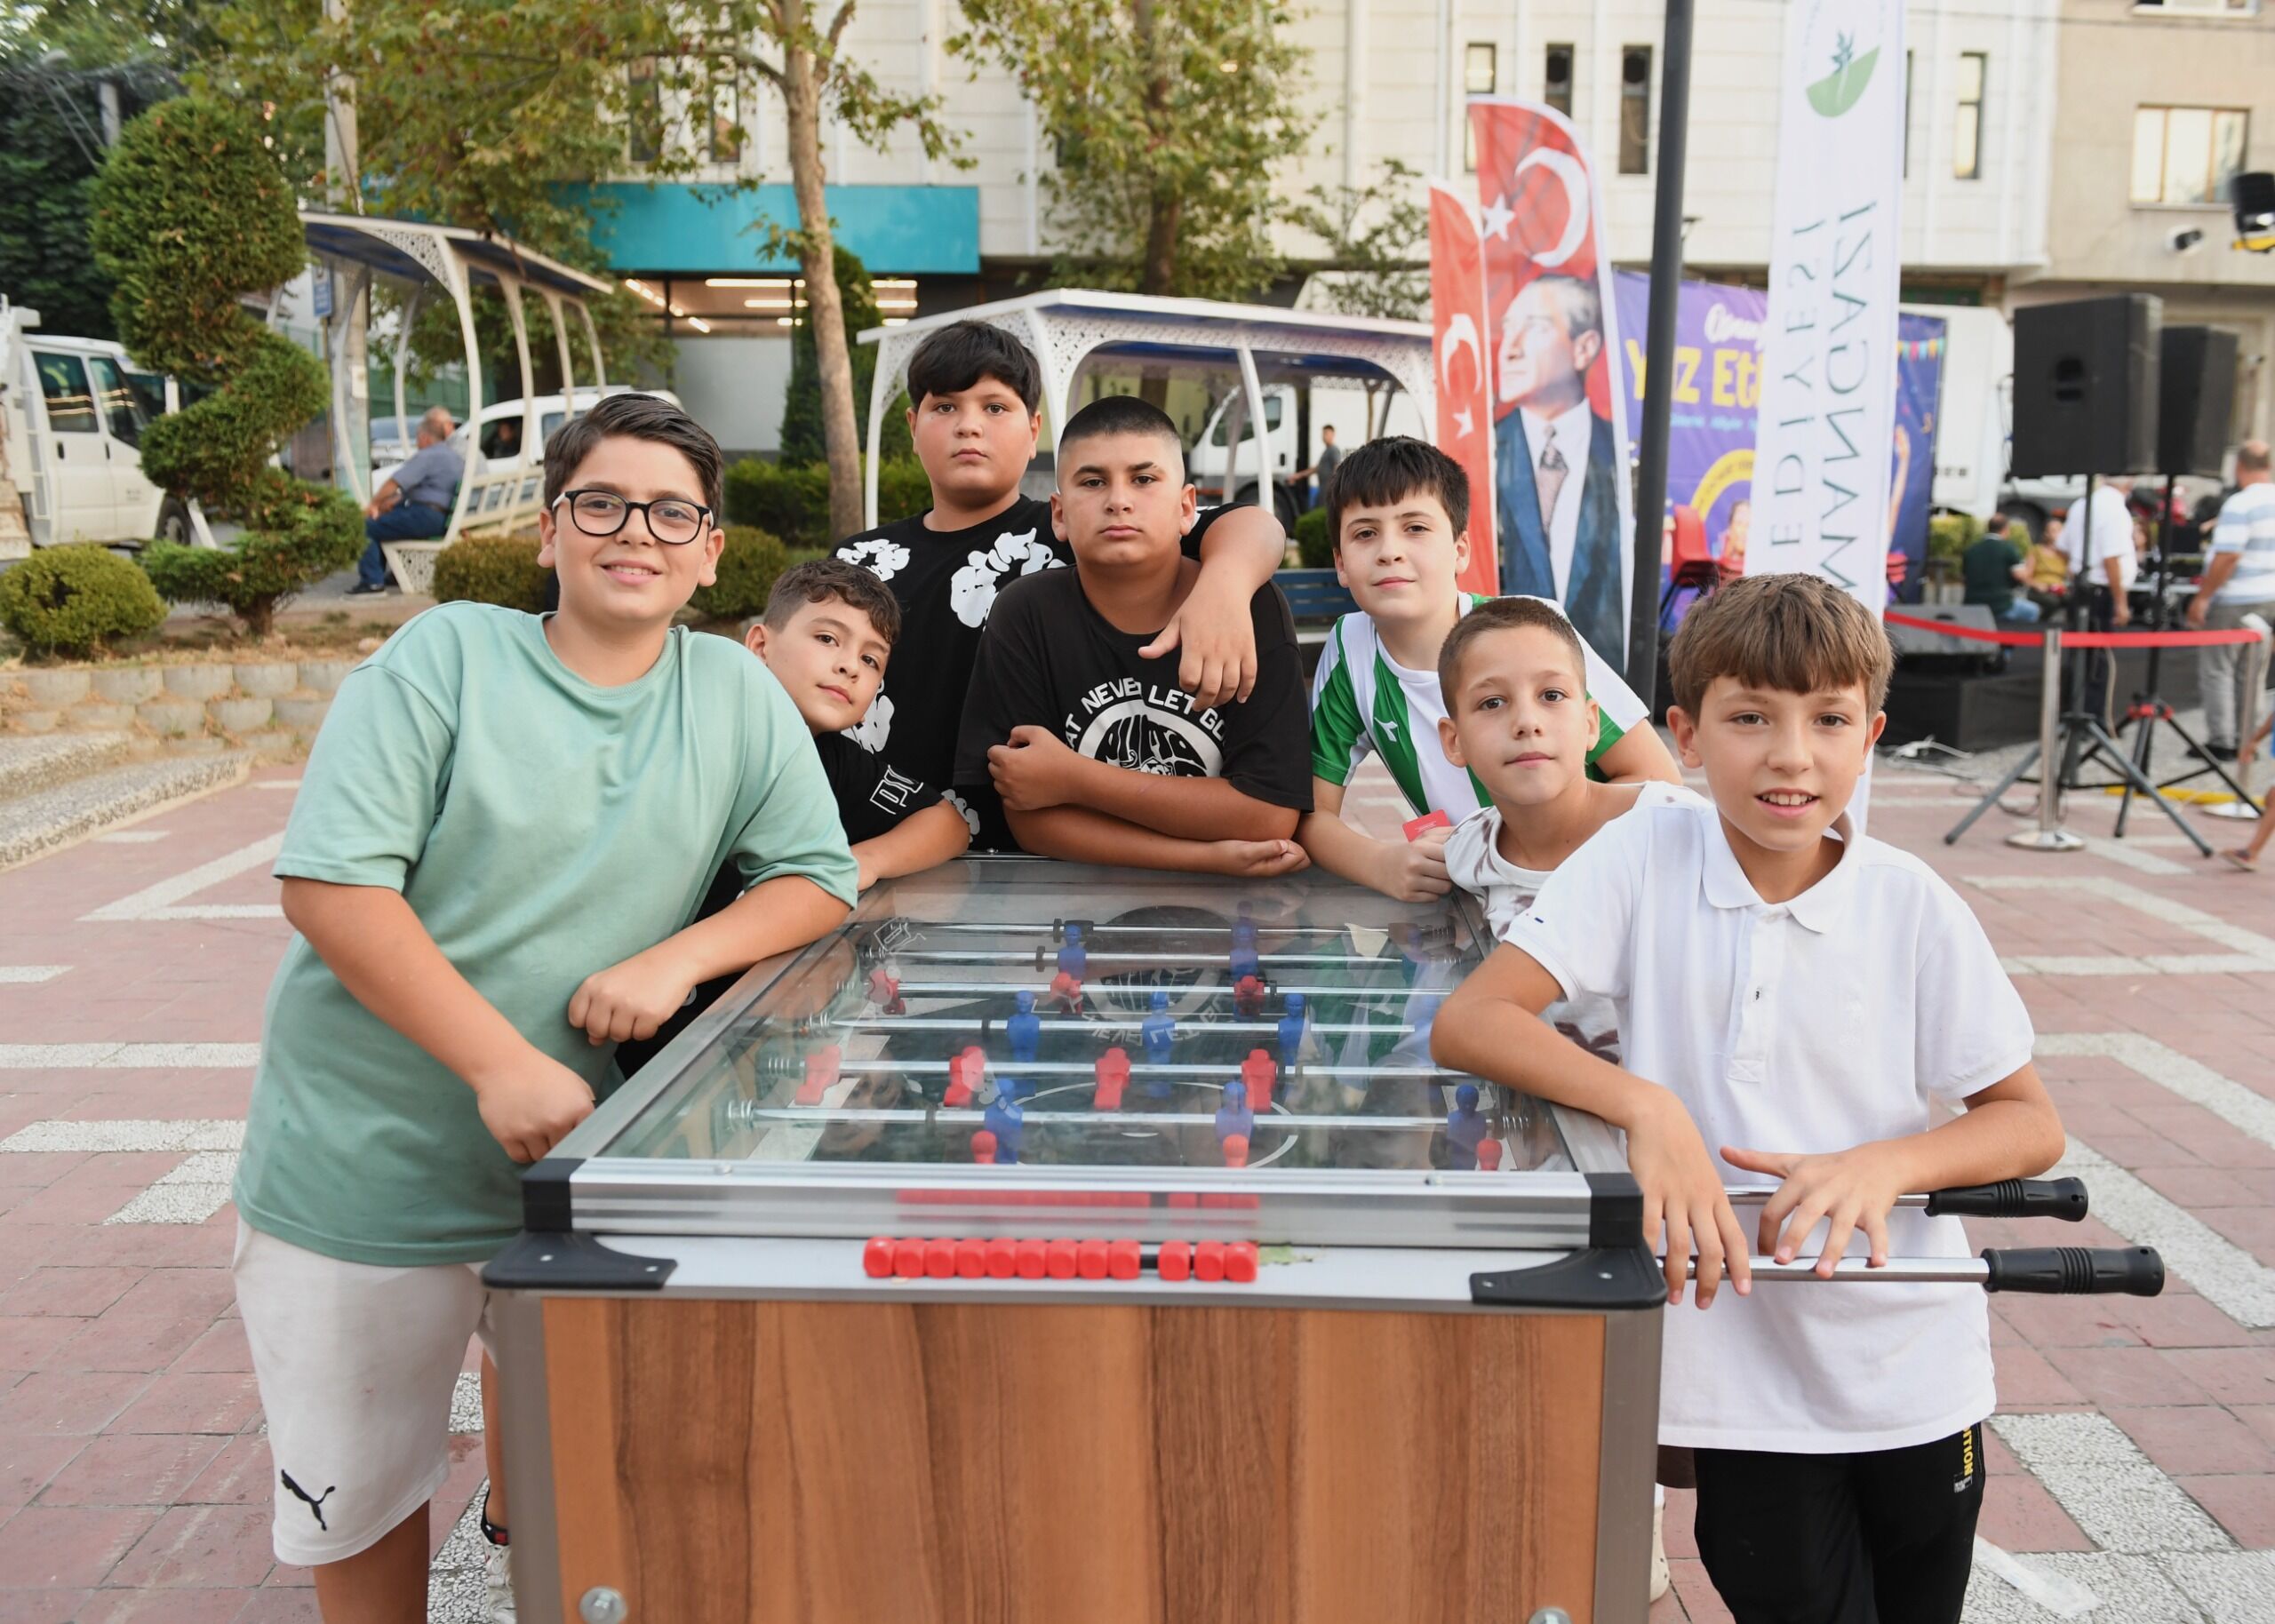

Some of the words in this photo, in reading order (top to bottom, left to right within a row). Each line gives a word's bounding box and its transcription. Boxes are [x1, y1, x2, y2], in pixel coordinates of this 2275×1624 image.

[1625, 338, 1702, 404] YZ
[1148, 685, 1197, 715] LET
[1962, 1427, 1974, 1477] ITION
